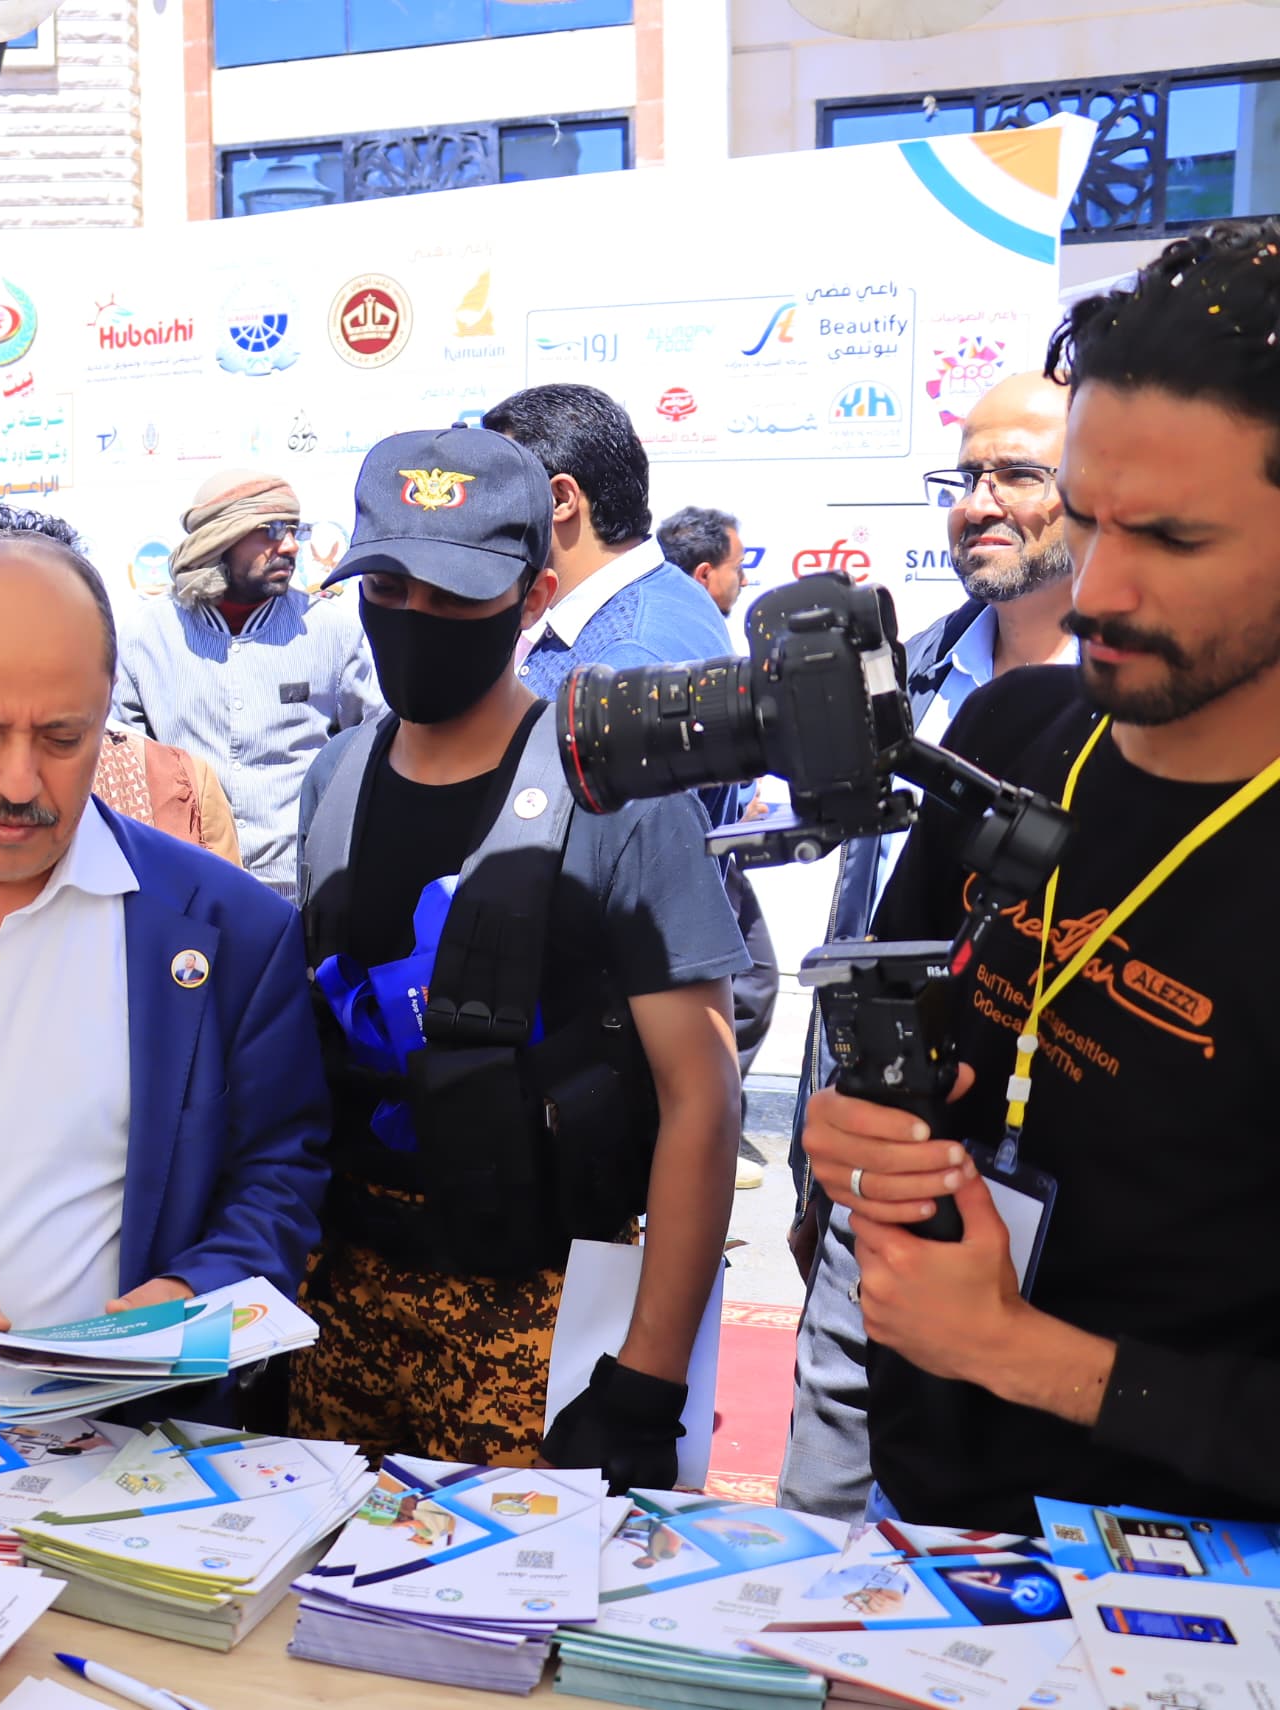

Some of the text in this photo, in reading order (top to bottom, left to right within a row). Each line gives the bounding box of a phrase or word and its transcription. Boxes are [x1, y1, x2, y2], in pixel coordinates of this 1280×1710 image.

[806, 280, 899, 306] راعي فضي
[99, 317, 194, 350] Hubaishi
[819, 313, 909, 337] Beautify
[443, 345, 505, 362] Kamaran
[2, 371, 34, 397] بيت
[792, 538, 871, 583] efe
